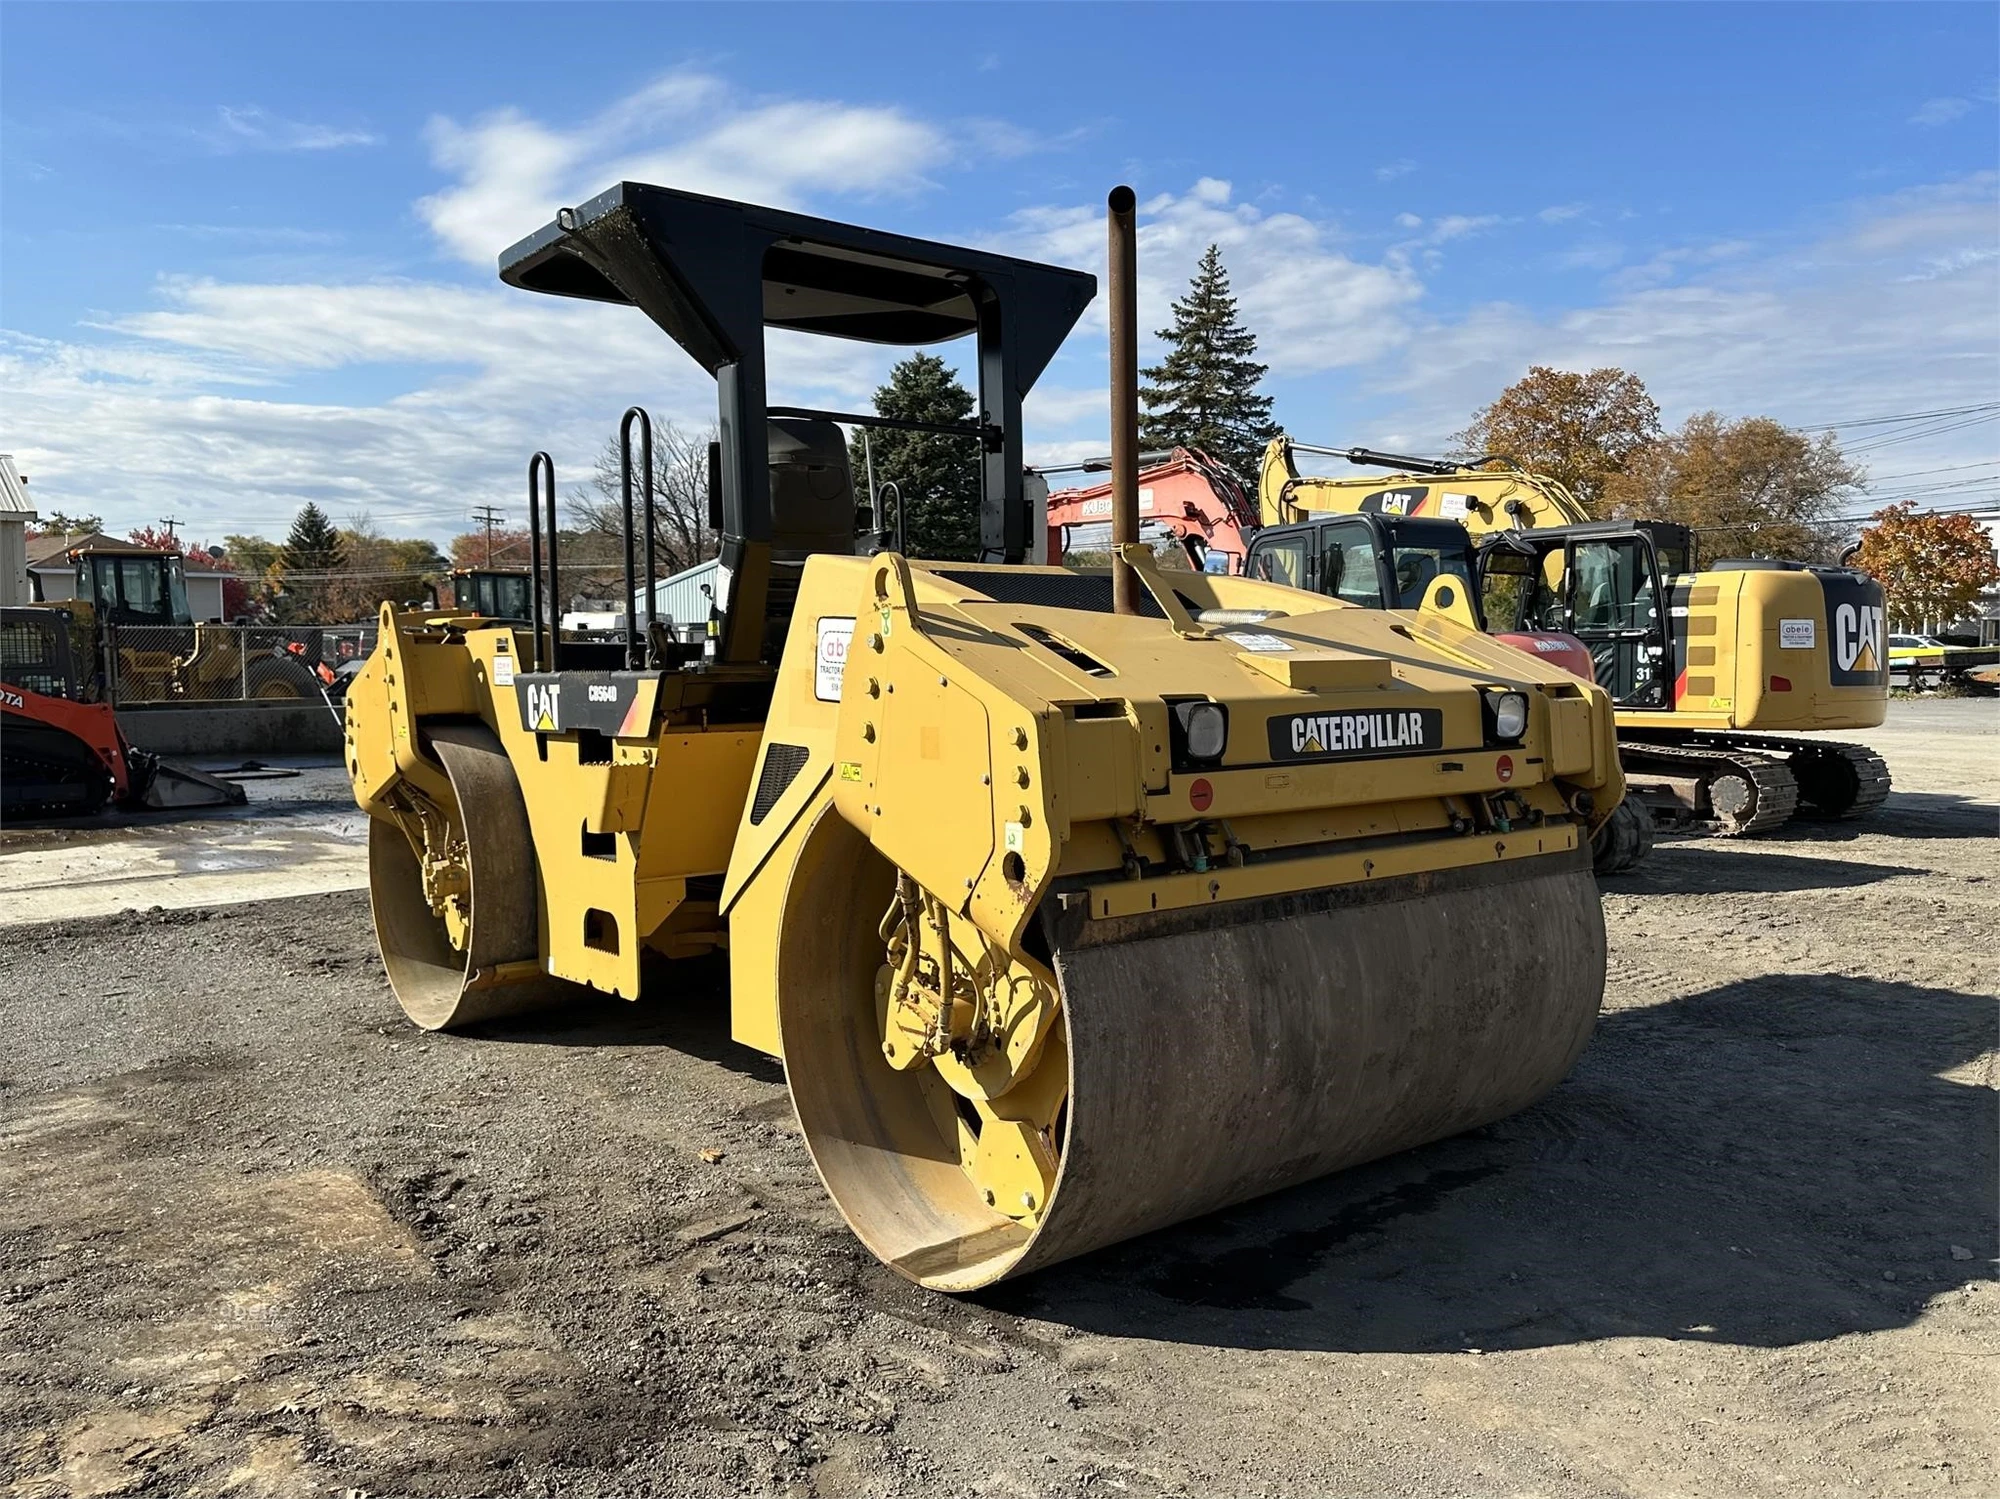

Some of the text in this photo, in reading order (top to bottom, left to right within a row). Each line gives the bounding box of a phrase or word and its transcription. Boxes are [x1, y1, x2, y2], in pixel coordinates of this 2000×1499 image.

[1381, 492, 1412, 516] CAT
[1785, 626, 1810, 634] abele
[1836, 603, 1882, 671] CAT
[527, 684, 560, 730] CAT
[1291, 712, 1424, 753] CATERPILLAR
